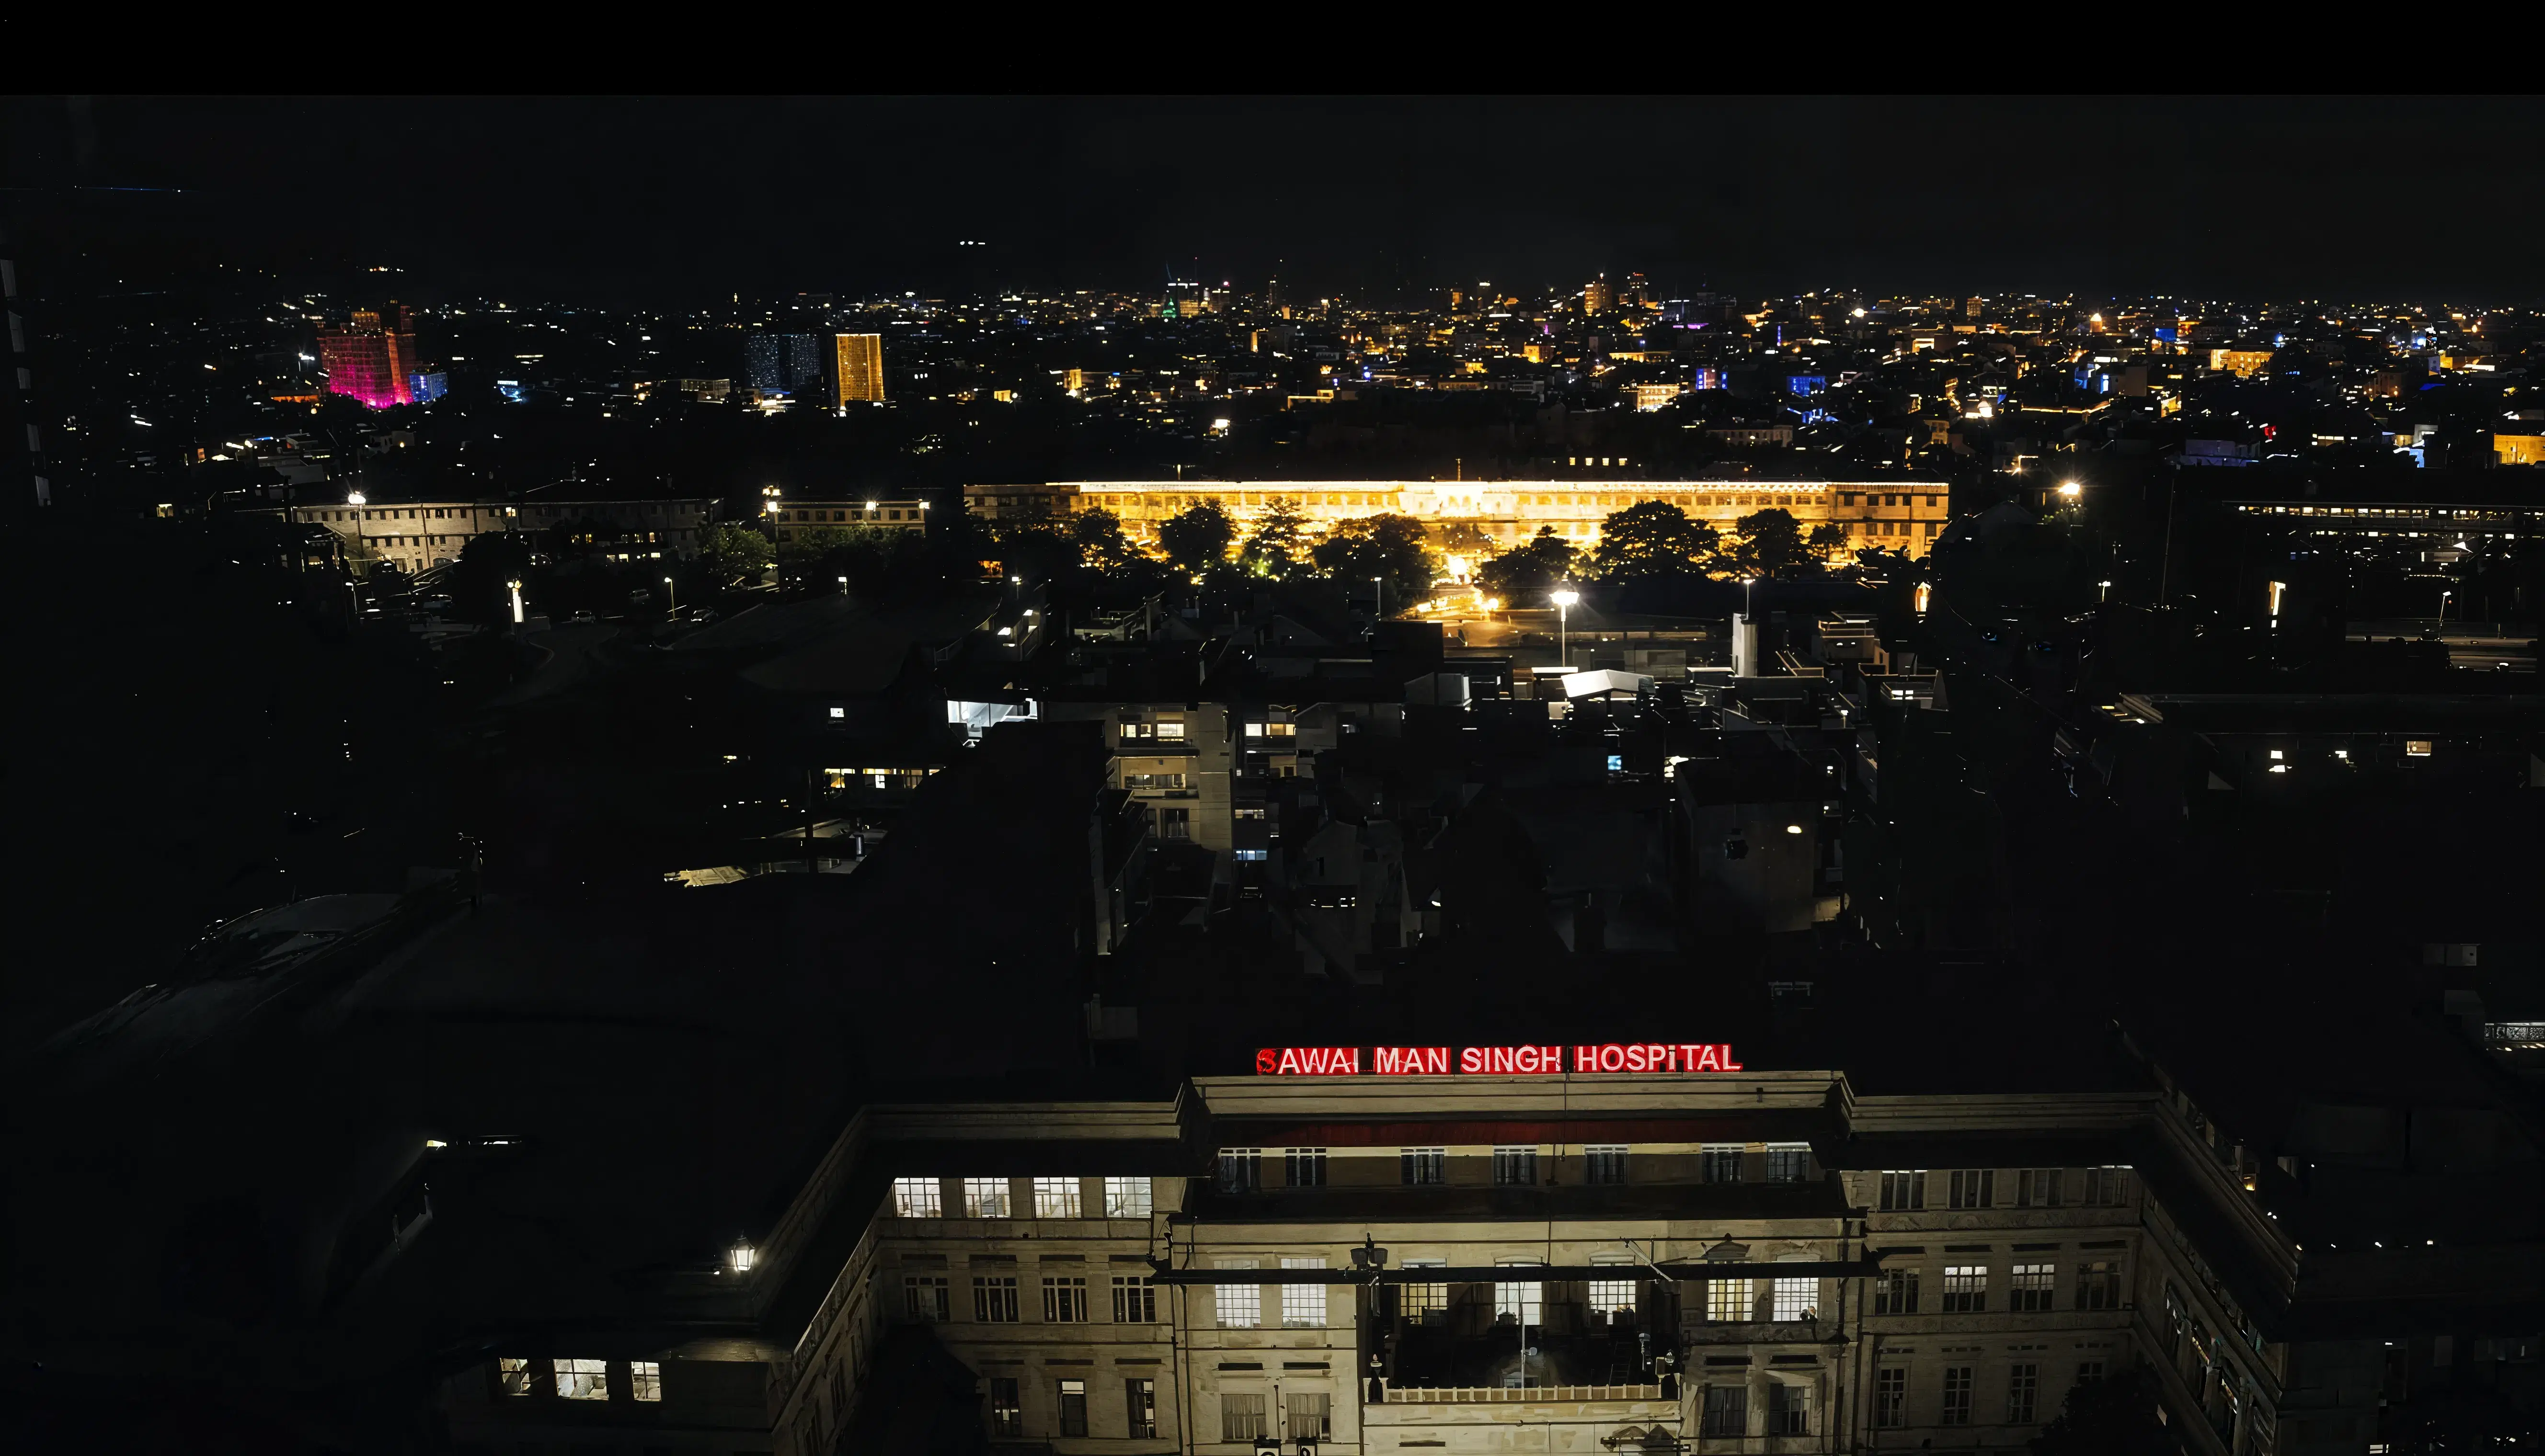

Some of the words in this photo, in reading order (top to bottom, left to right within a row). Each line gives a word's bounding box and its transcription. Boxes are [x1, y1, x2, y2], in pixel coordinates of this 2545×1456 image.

[1256, 1047, 1359, 1074] SAWAI
[1376, 1047, 1447, 1073] MAN
[1461, 1046, 1561, 1072] SINGH
[1578, 1045, 1741, 1071] HOSPITAL
